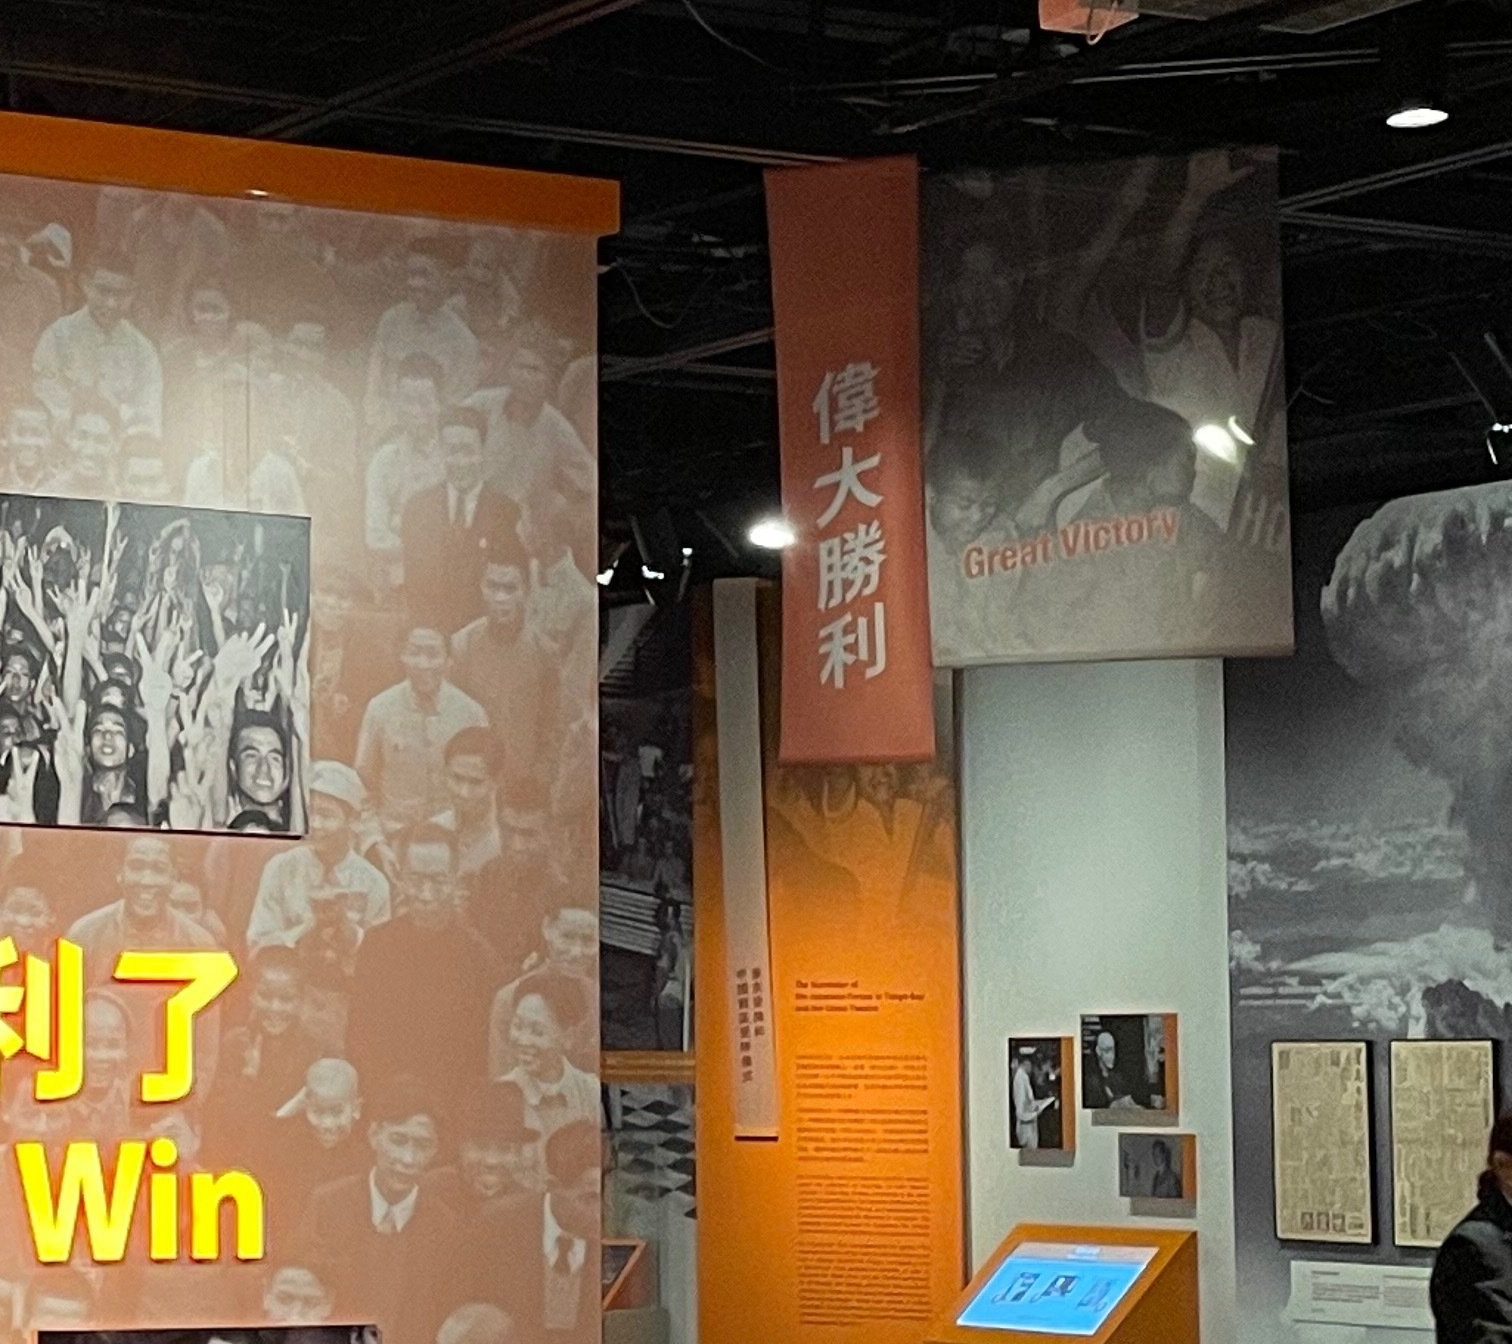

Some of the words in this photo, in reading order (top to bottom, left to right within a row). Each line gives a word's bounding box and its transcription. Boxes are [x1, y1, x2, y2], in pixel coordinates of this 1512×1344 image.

[812, 361, 887, 689] 偉大勝利
[962, 532, 1054, 580] Great
[1059, 507, 1182, 557] Victory
[15, 1135, 265, 1265] Win
